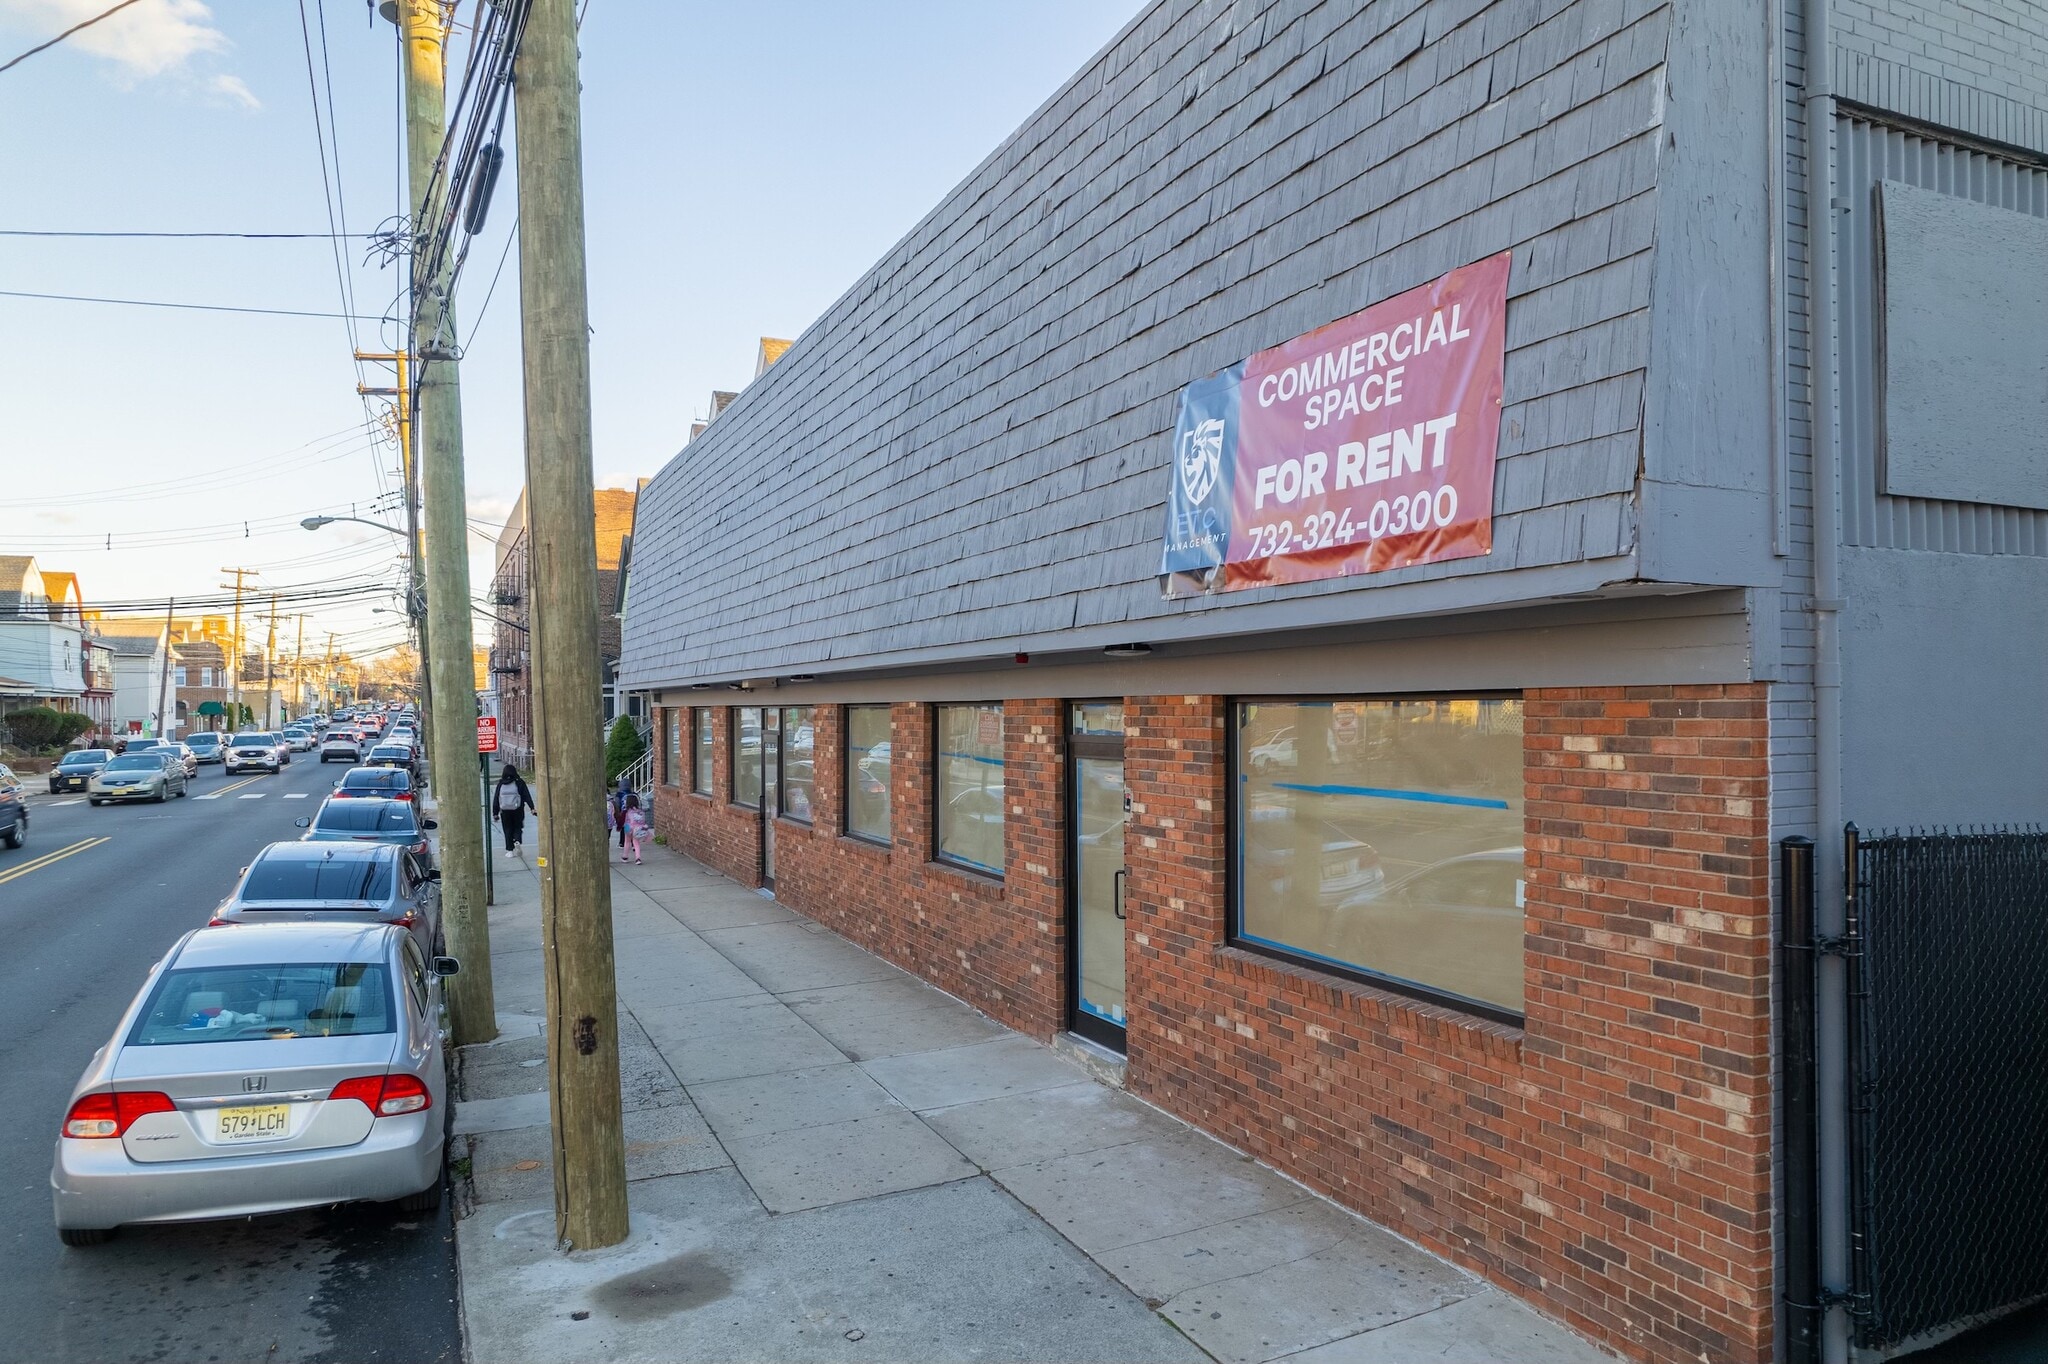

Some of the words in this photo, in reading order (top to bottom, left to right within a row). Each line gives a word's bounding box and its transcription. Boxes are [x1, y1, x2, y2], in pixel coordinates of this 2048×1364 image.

[1258, 304, 1470, 408] COMMERCIAL
[1303, 366, 1405, 430] SPACE
[1254, 451, 1328, 510] FOR
[1335, 413, 1457, 490] RENT
[1177, 507, 1216, 535] ETC
[1246, 485, 1458, 560] 732-324-0300
